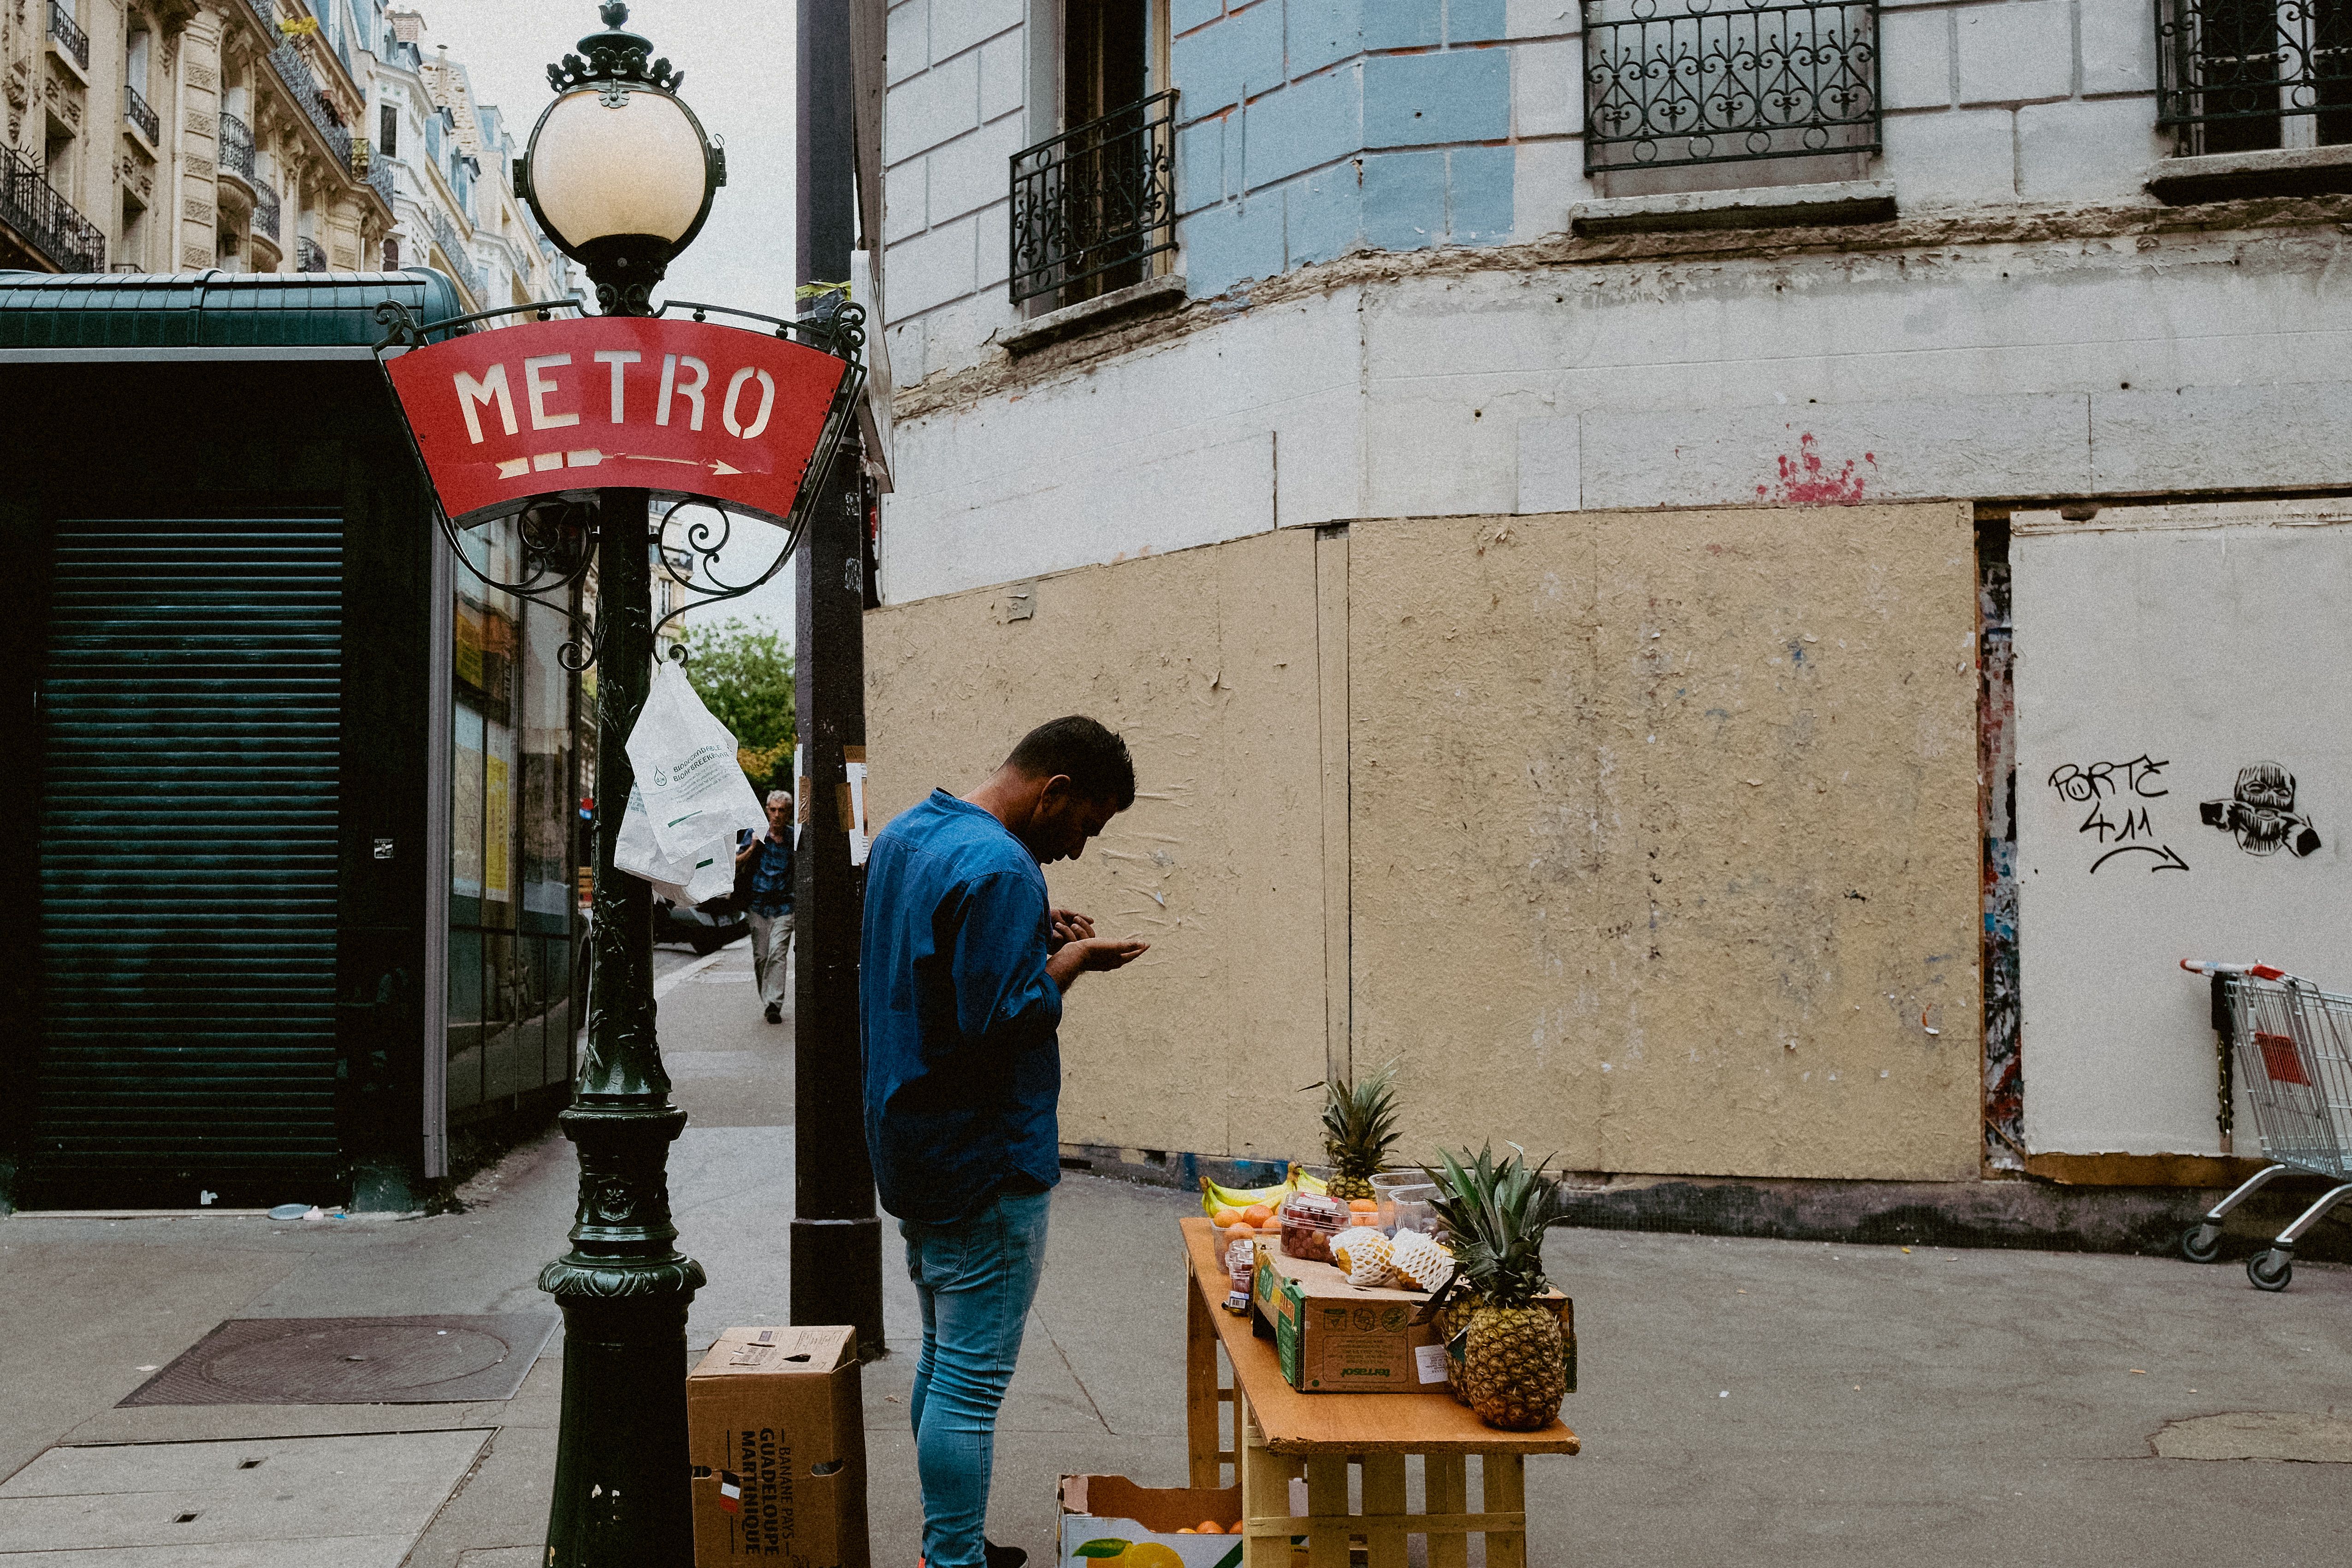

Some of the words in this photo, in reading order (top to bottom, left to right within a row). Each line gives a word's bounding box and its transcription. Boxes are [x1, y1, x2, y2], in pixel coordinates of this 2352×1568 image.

[452, 349, 776, 444] METRO
[673, 745, 722, 772] BIODEGRADABLE
[673, 752, 729, 781] BIOAFBREEKBAAR
[2049, 754, 2169, 802] PORTE
[741, 1431, 760, 1555] MARTINIQUE
[760, 1427, 779, 1556] GUADELOUPE
[779, 1447, 793, 1504] BANANE
[781, 1508, 794, 1539] PAYS
